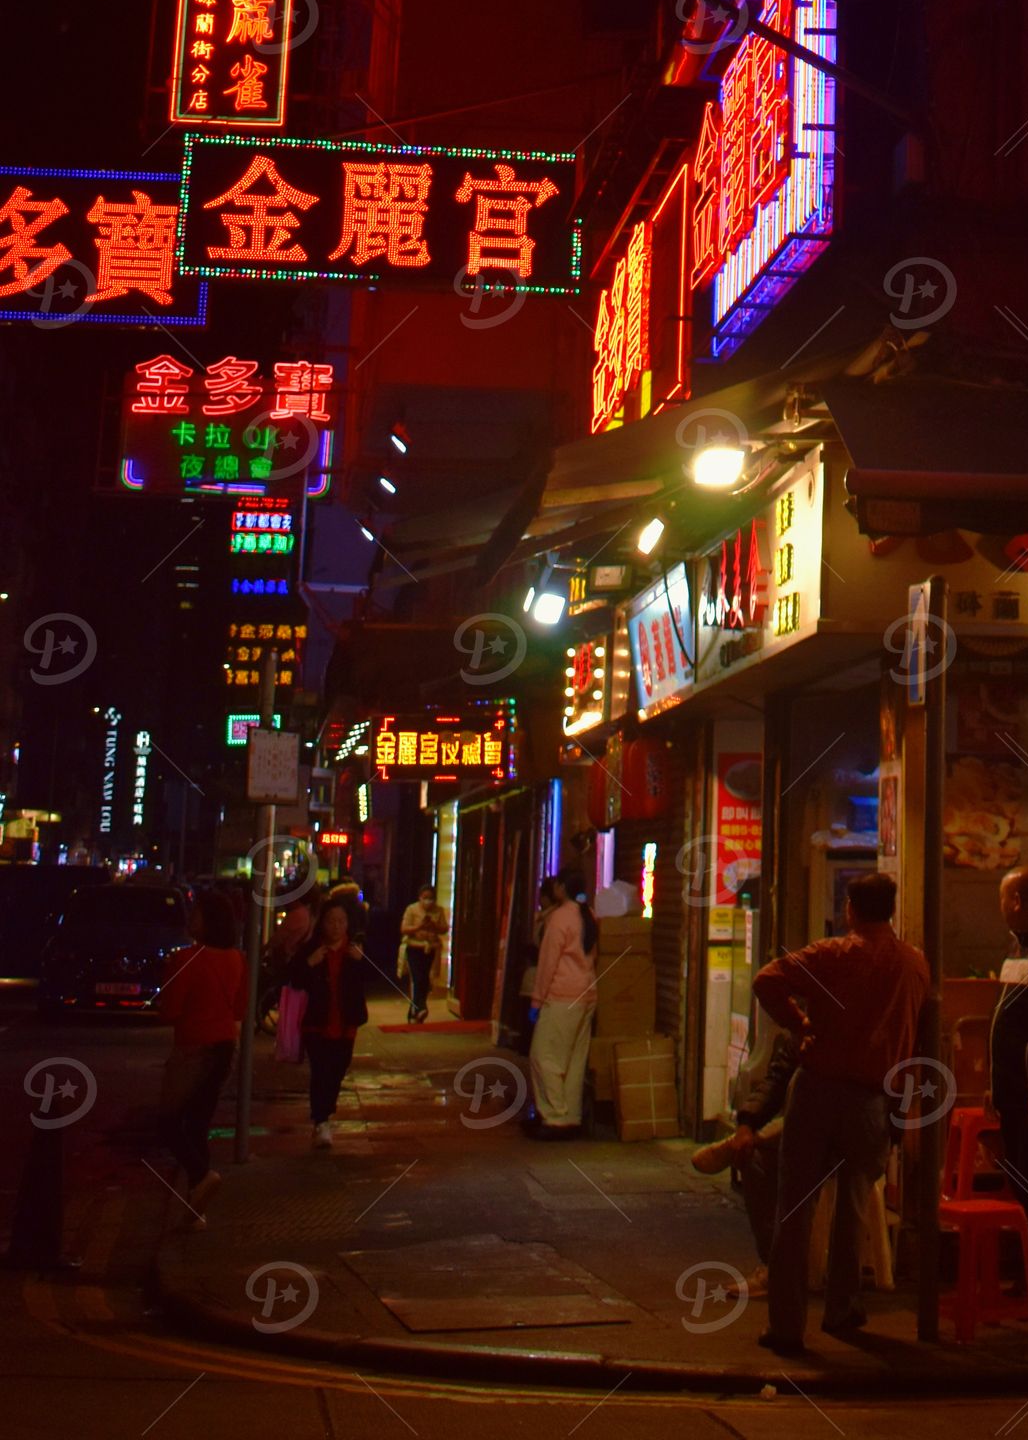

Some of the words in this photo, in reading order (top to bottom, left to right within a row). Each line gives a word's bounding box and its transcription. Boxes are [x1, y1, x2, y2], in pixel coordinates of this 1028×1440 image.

[204, 155, 559, 278] 金麗宮
[132, 354, 334, 421] 金多寶
